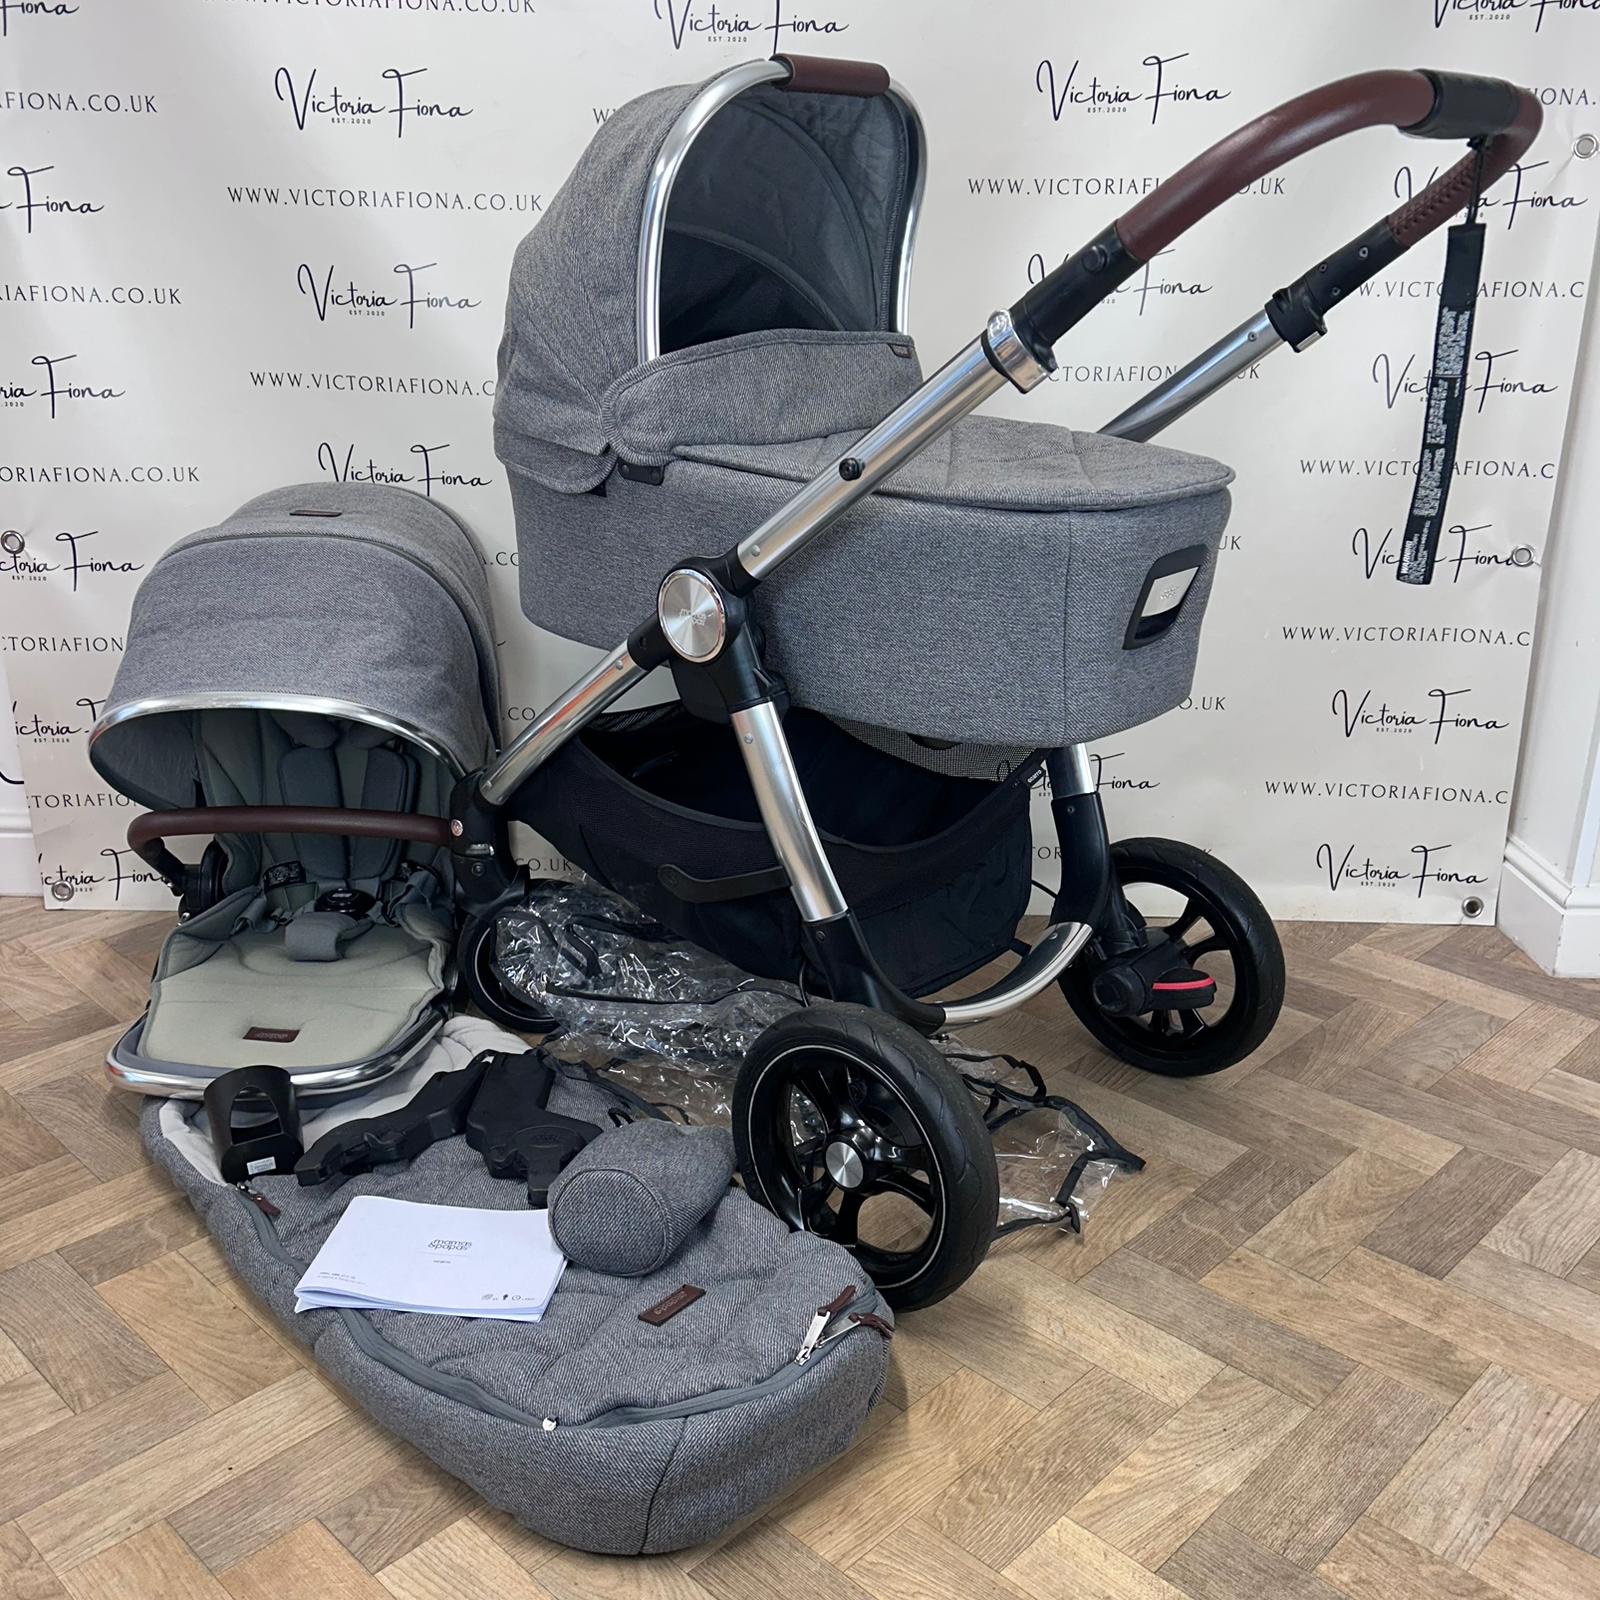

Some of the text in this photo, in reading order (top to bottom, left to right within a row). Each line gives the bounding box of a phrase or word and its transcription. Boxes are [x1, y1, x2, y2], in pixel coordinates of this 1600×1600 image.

[654, 0, 762, 50] Victoria
[0, 91, 158, 113] FIONA.CO.UK
[275, 67, 474, 138] Victoria Fiona
[1036, 52, 1232, 125] Victoria Fiona
[227, 186, 543, 212] WWW.VICTORIAFIONA.CO.UK
[0, 284, 182, 305] IAFIONA.CO.UK
[297, 262, 482, 329] Victoria Fiona
[32, 354, 126, 419] Fiona
[1474, 350, 1558, 414] Fiona
[318, 442, 492, 497] Victoria Fiona
[55, 530, 145, 592] Fiona
[1332, 689, 1509, 744] Victoria Fiona
[1316, 843, 1489, 899] Victoria Fiona
